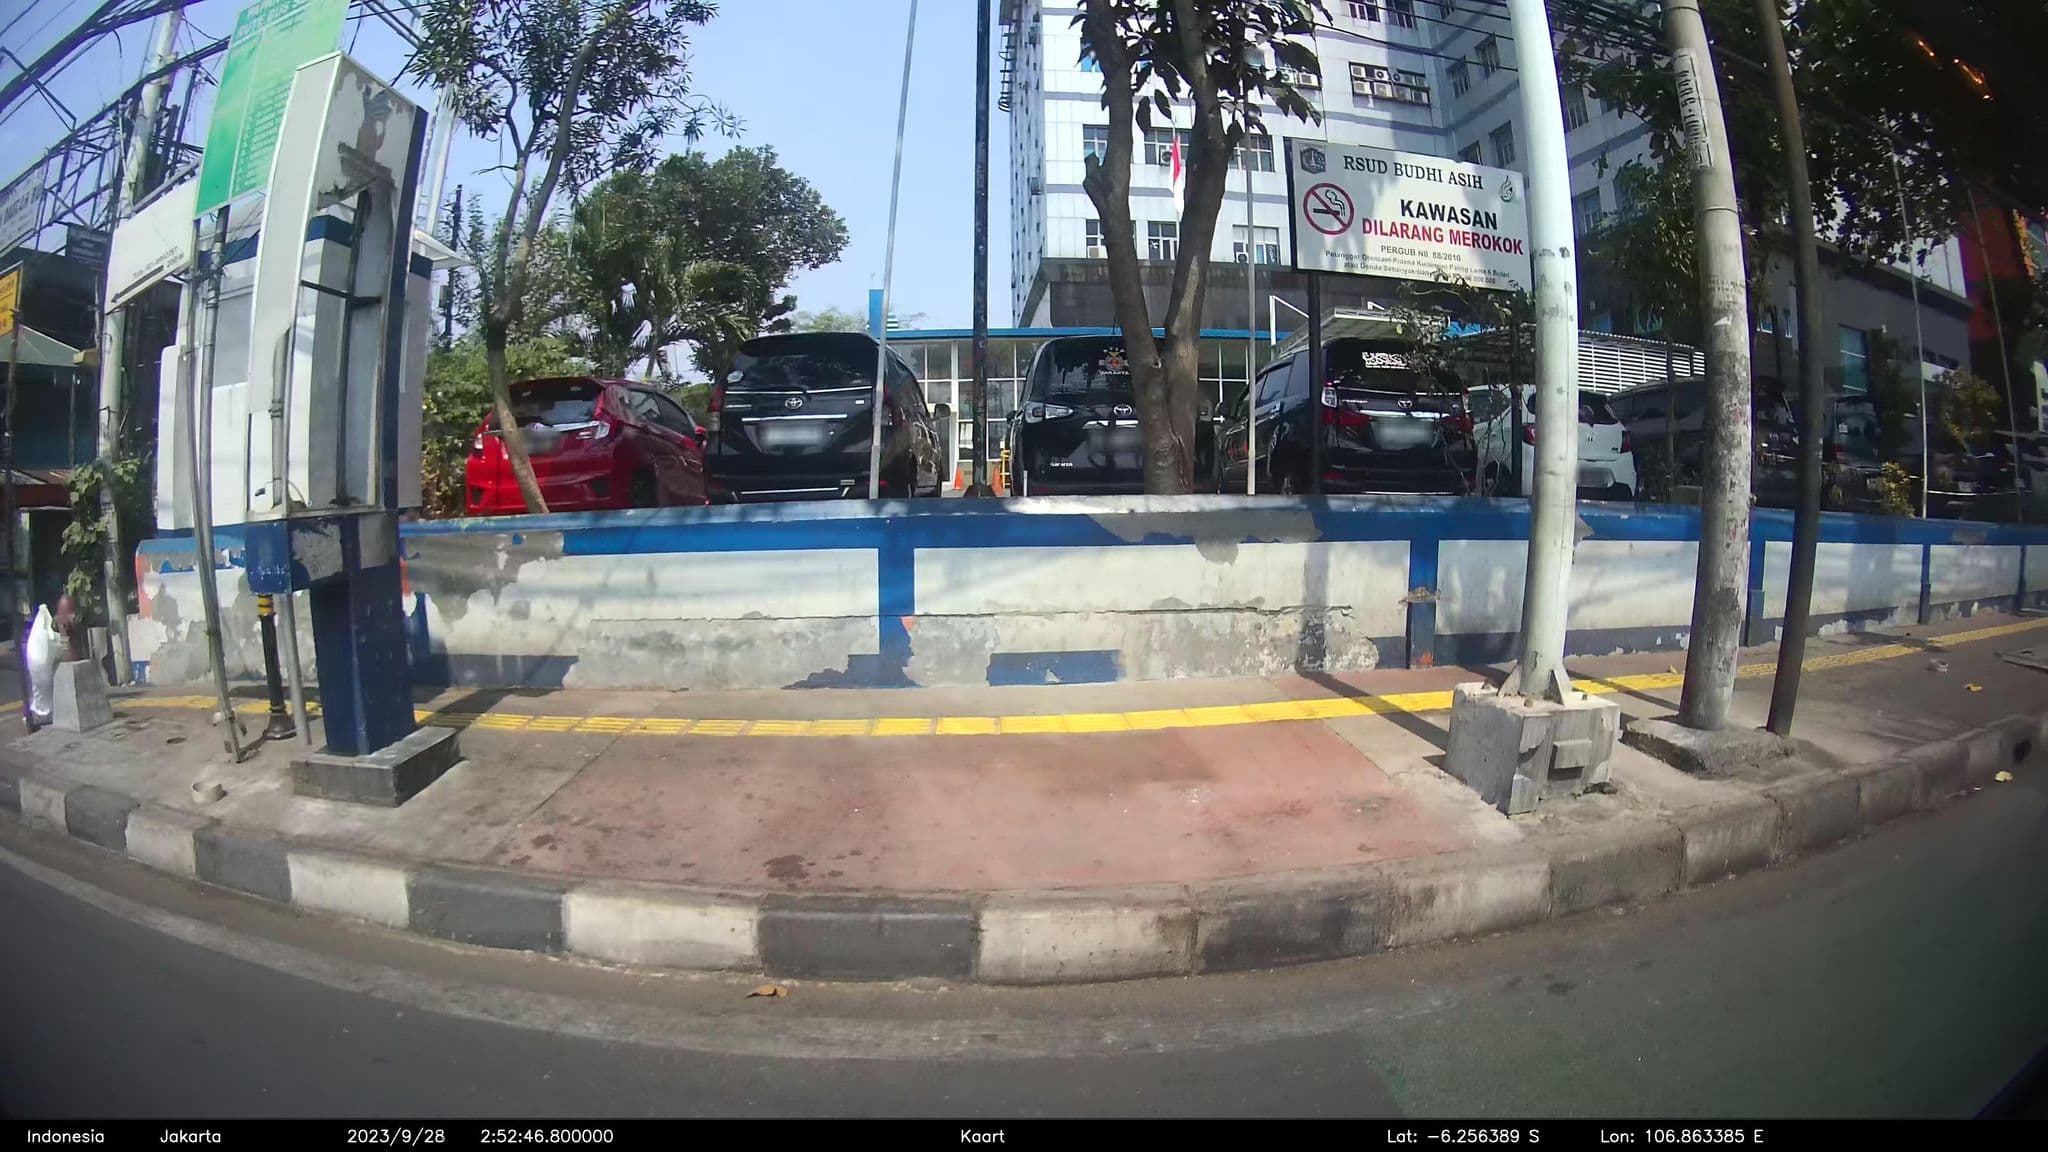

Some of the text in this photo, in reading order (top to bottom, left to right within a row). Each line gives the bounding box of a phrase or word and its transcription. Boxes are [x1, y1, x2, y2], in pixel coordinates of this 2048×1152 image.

[1343, 155, 1484, 189] RSUD BUDHI ASIH
[1400, 199, 1498, 230] KAWASAN
[1362, 217, 1524, 255] DILARANG MEROKOK
[1381, 245, 1416, 256] PERGUB
